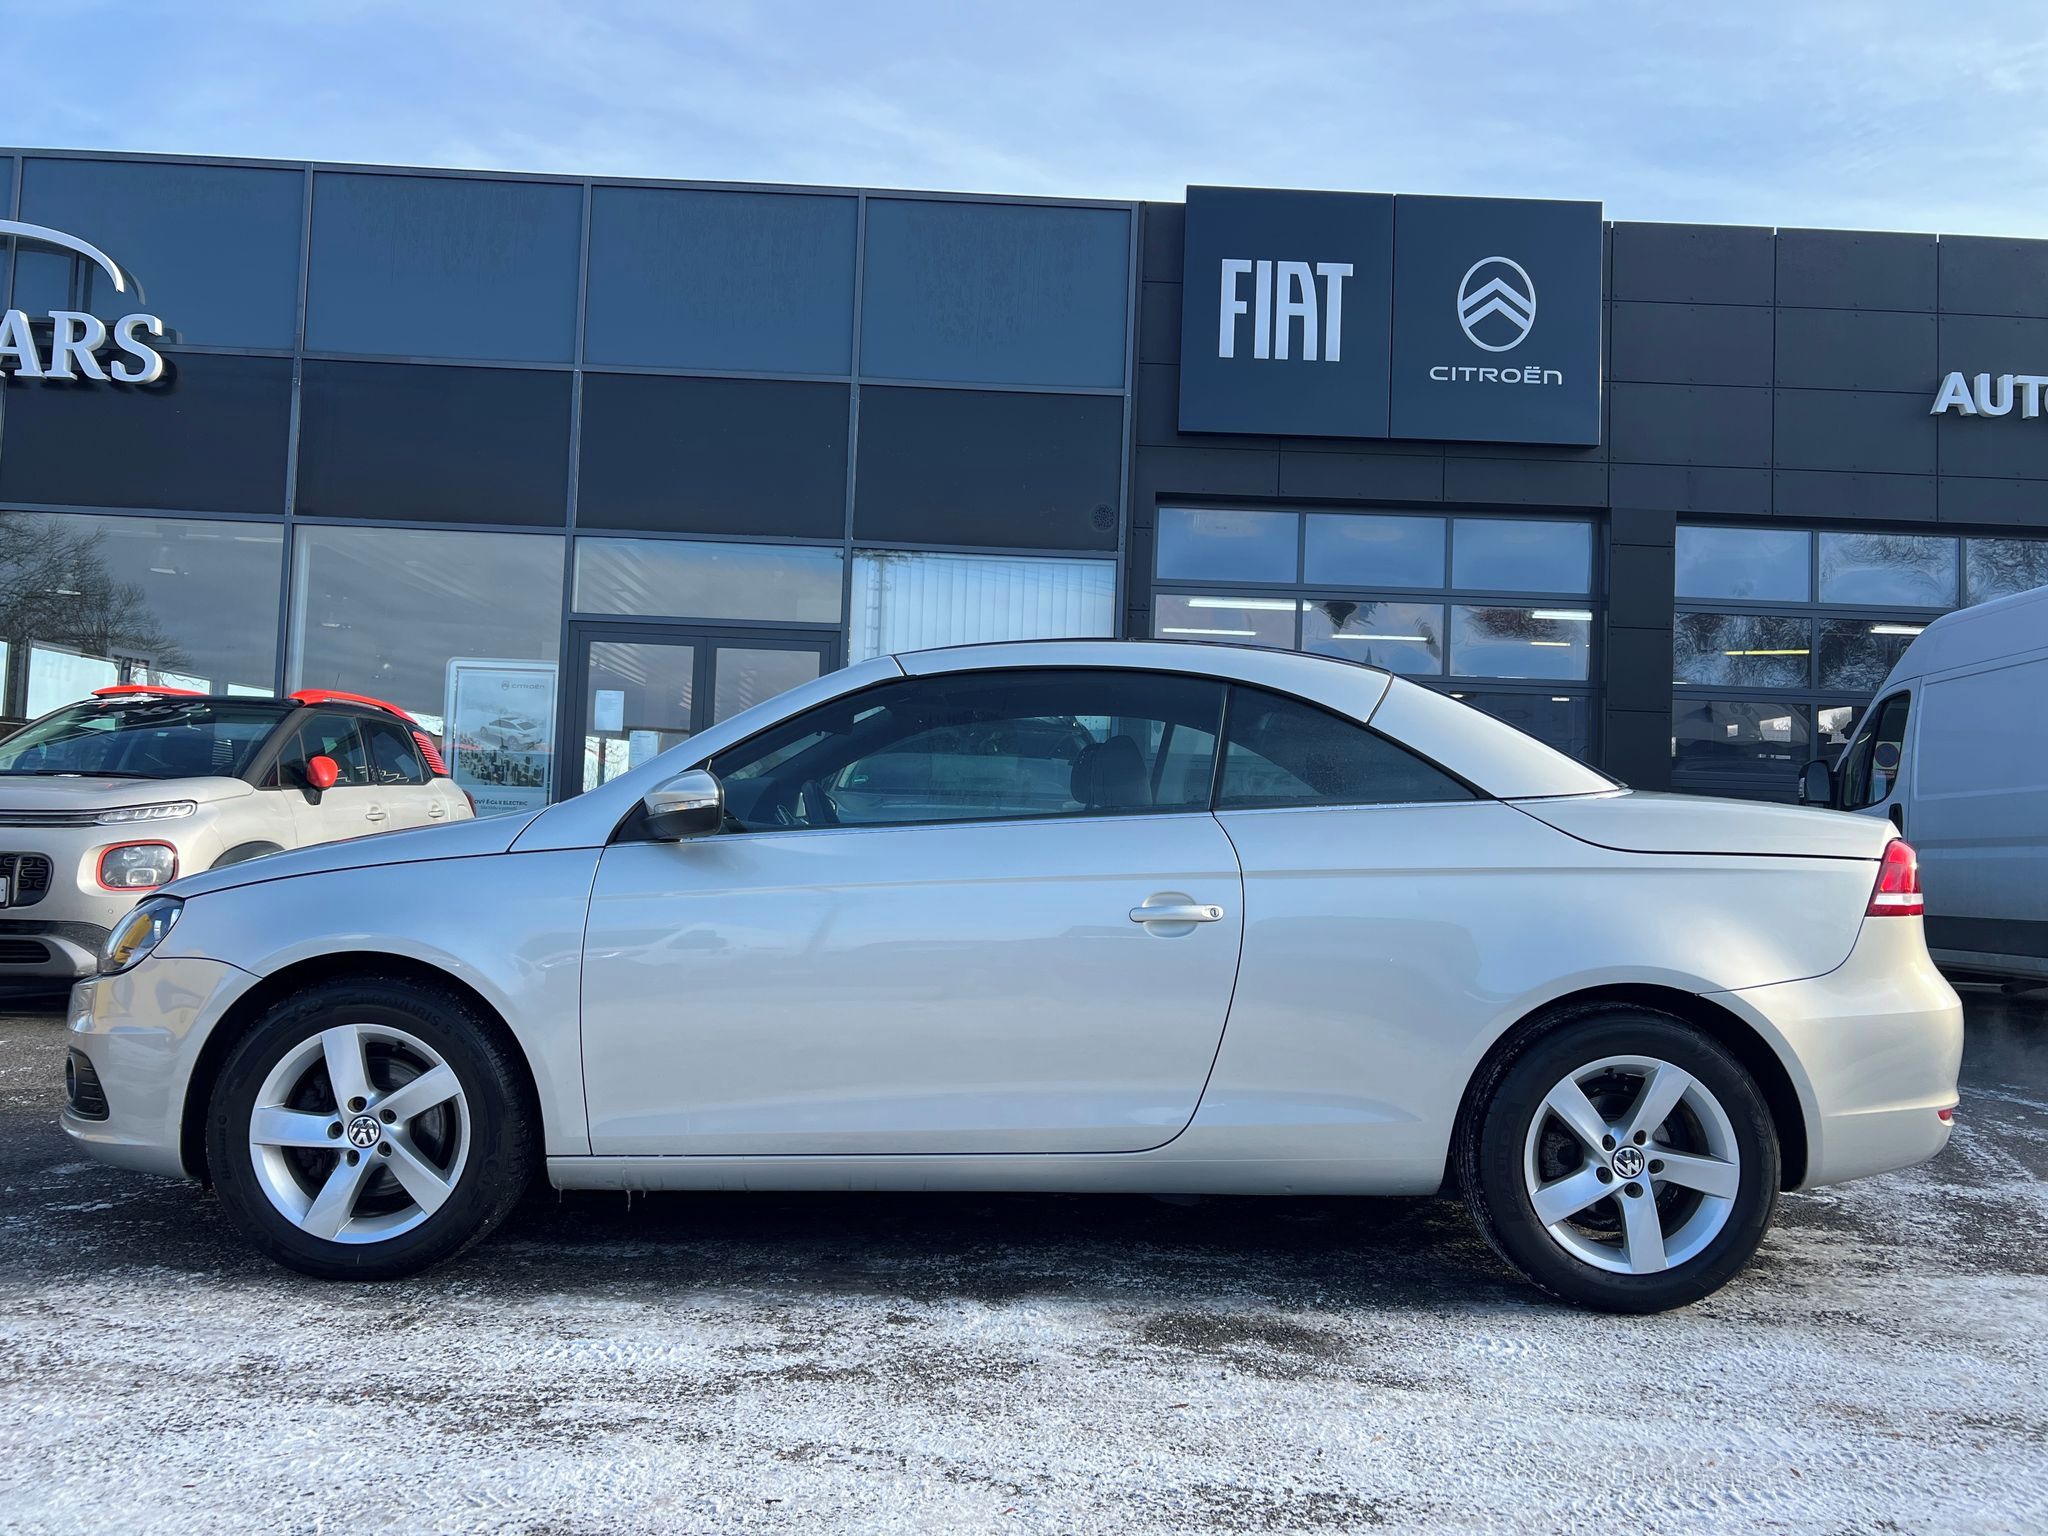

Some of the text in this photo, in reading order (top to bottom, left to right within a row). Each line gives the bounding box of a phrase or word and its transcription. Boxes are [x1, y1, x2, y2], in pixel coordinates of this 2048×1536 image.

[0, 310, 163, 384] ARS
[1219, 258, 1354, 362] FIAT
[1930, 371, 2048, 419] AUT
